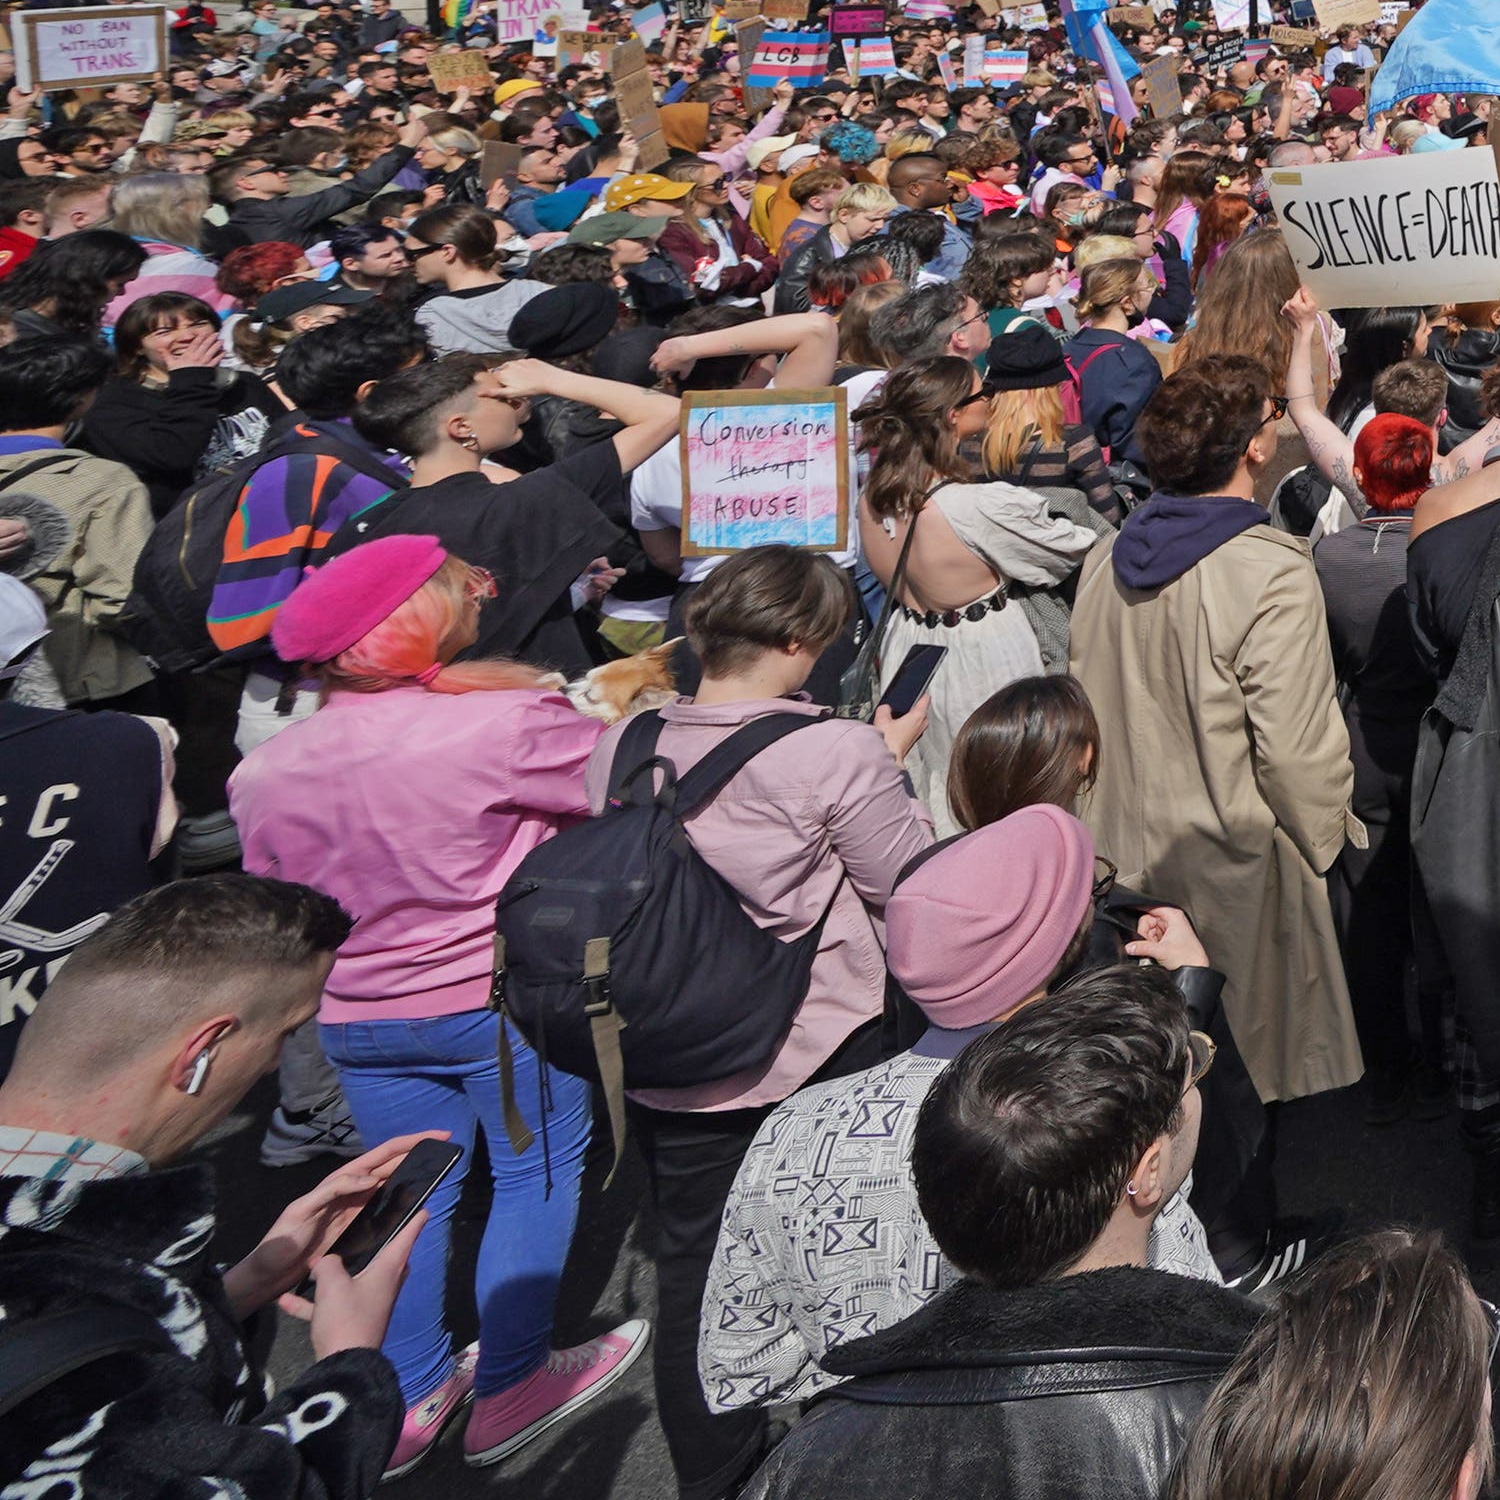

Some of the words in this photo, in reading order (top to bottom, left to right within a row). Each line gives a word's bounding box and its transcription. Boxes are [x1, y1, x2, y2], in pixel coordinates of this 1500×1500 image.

[62, 24, 84, 35] NO
[101, 21, 131, 33] BAN
[59, 37, 128, 51] WITHOUT
[763, 46, 800, 64] LGB
[700, 411, 830, 446] Conversion
[727, 455, 807, 481] therapy
[714, 496, 798, 521] ABUSE
